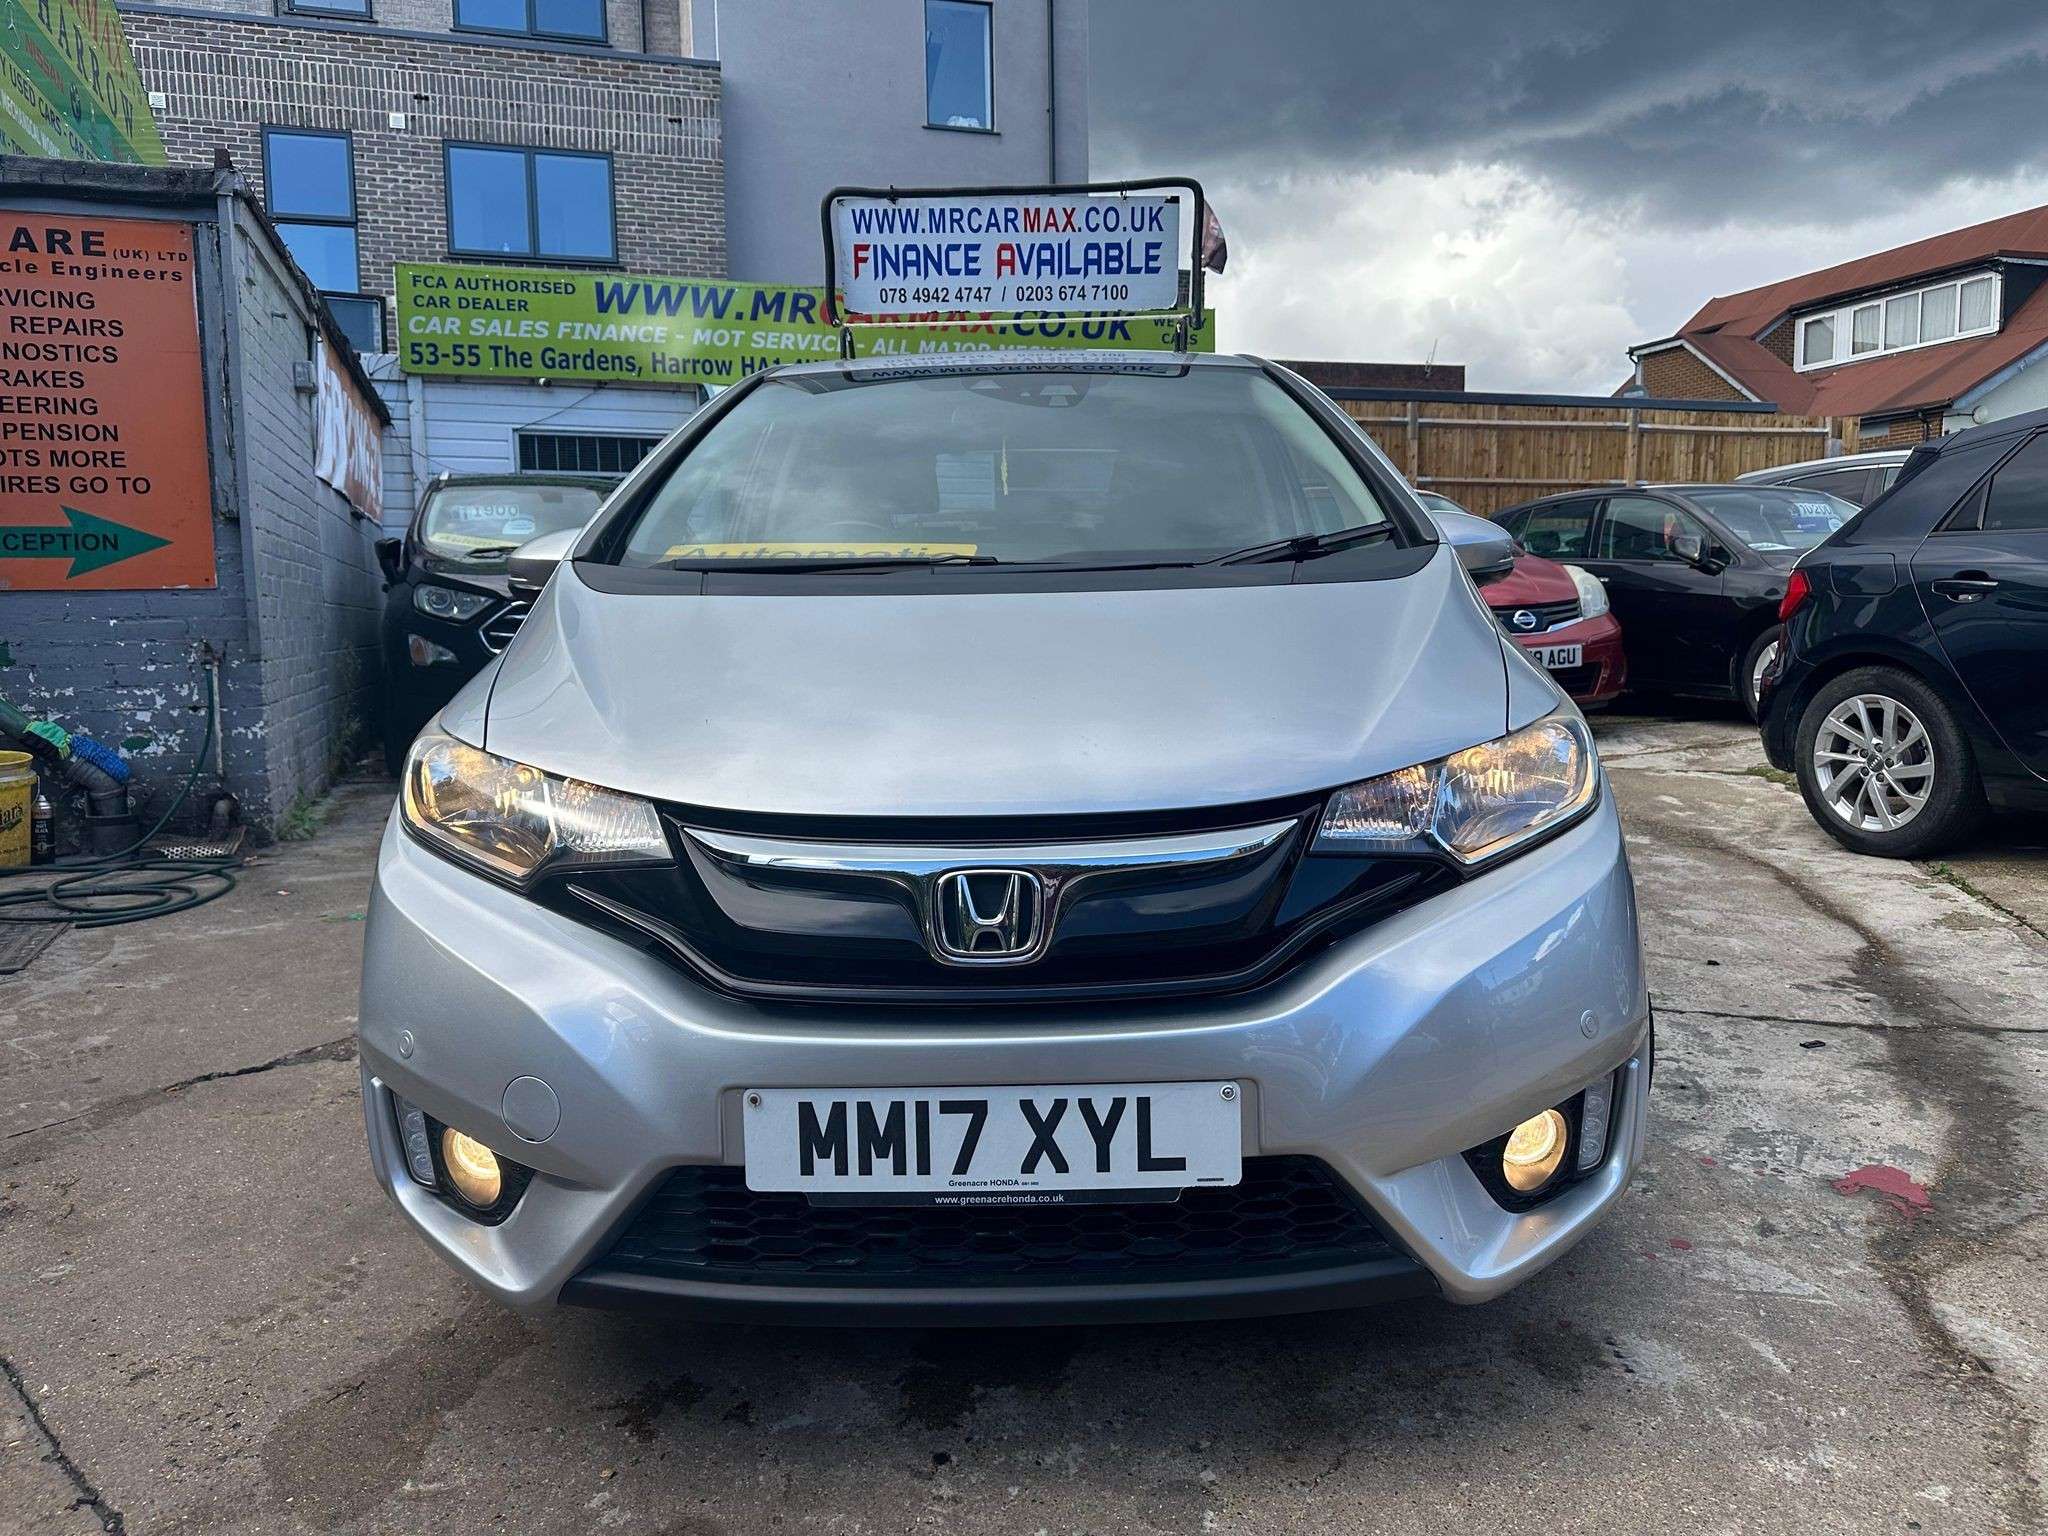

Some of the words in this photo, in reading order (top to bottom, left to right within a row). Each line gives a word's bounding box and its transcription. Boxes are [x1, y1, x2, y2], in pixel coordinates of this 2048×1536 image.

[9, 63, 36, 107] USED
[39, 97, 61, 136] CARS
[851, 206, 1164, 234] WWW.MRCARMAX.CO.UK
[8, 227, 106, 257] ARE
[113, 249, 150, 262] (UK)
[158, 251, 188, 262] LTD
[853, 243, 982, 280] FINANCE
[996, 237, 1163, 280] AVAILABLE
[0, 259, 38, 274] cle
[51, 260, 184, 282] Engineers
[412, 275, 448, 289] FCA
[454, 277, 576, 295] AUTHORISED
[880, 287, 907, 303] 078
[912, 286, 949, 303] 4942
[955, 286, 992, 303] 4747
[1002, 286, 1007, 302] /
[1016, 285, 1053, 302] 0203
[1058, 285, 1087, 301] 674
[1092, 284, 1129, 301] 7100
[413, 295, 450, 309] CAR
[458, 296, 529, 312] DEALER
[10, 316, 124, 337] REPAIRS
[408, 316, 461, 335] CAR
[469, 318, 549, 338] SALES
[557, 321, 667, 344] FINANCE
[693, 328, 745, 347] MOT
[751, 331, 842, 352] SERVIC
[871, 338, 912, 356] ALL
[2, 342, 119, 363] NOSTICS
[410, 343, 481, 367] 53-55
[489, 345, 532, 368] The
[541, 346, 641, 377] Gardens,
[652, 352, 738, 377] Harrow
[0, 396, 98, 415] EERING
[3, 423, 119, 442] PENSION
[50, 450, 127, 469] MORE
[69, 476, 109, 494] GO
[116, 477, 150, 494] TO
[2, 533, 119, 551] CEPTION
[1548, 648, 1576, 666] AGU
[798, 1099, 988, 1176] MM17
[1018, 1096, 1187, 1174] XYL
[990, 1179, 1019, 1187] HONDA
[934, 1194, 1065, 1206] www.greenacrehonda.co.uk
